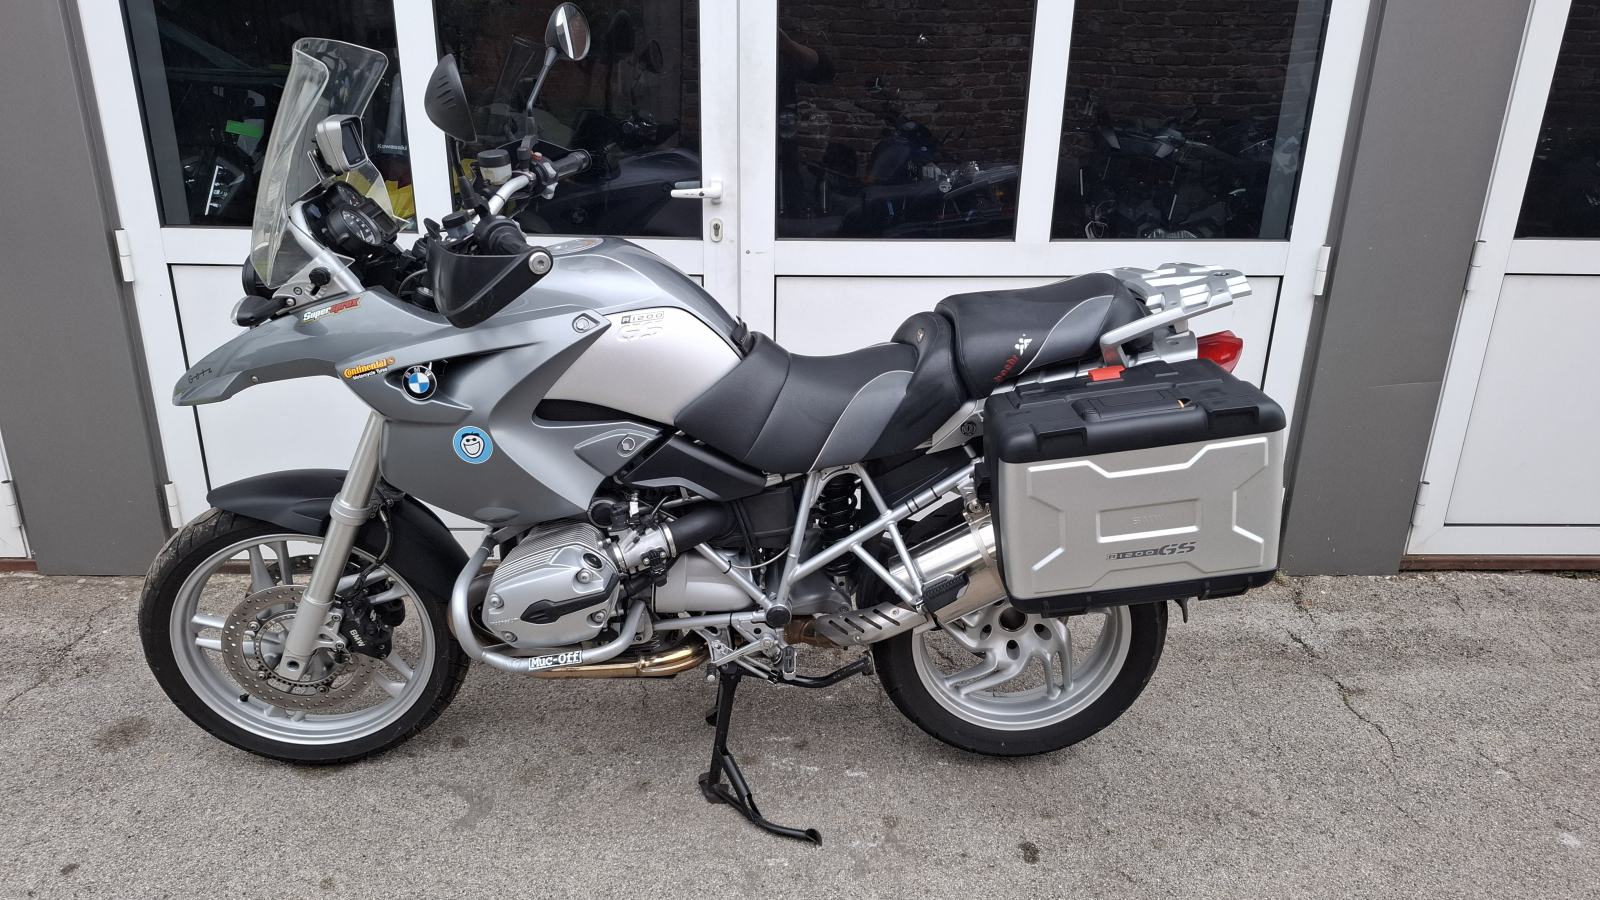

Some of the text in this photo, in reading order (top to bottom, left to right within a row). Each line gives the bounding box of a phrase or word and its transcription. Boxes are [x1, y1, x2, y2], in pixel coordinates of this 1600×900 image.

[343, 358, 387, 378] Continental
[350, 629, 366, 647] BMW
[530, 652, 581, 668] Muc-Off
